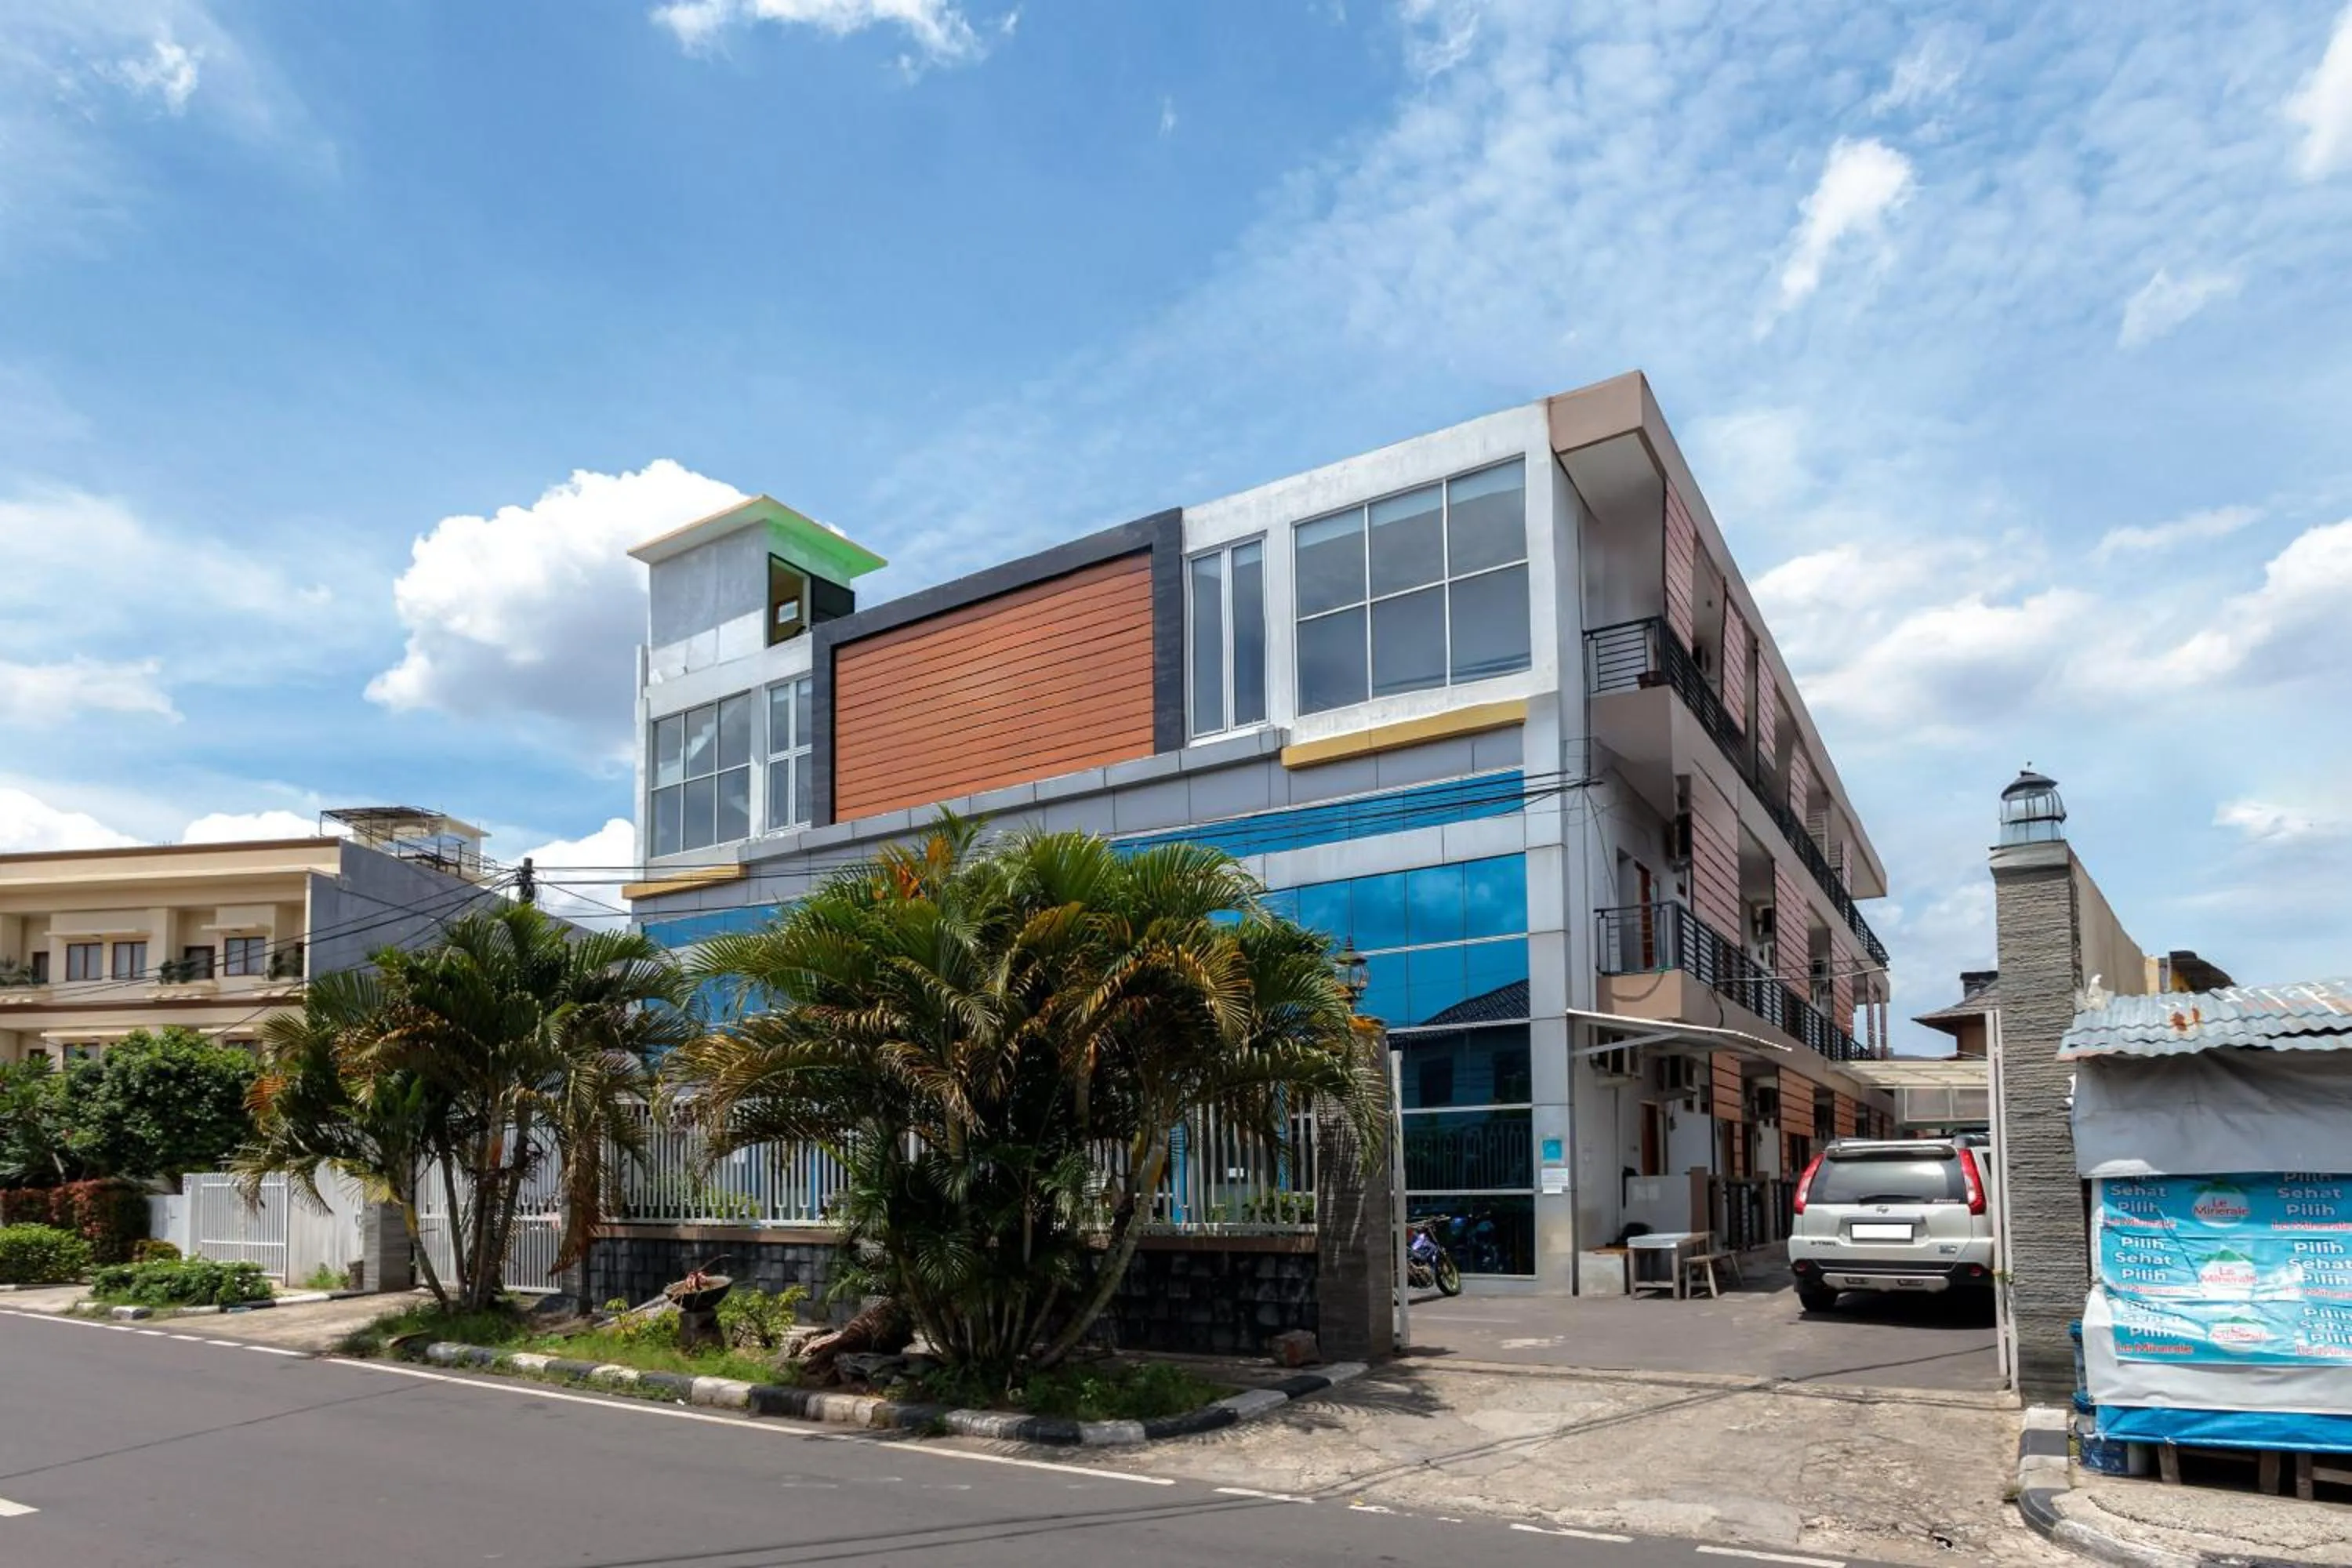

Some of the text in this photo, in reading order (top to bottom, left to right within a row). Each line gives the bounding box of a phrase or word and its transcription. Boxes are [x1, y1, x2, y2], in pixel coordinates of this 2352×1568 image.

[2110, 1185, 2167, 1198] Sehat
[2278, 1187, 2342, 1200] Sehat
[2286, 1203, 2336, 1217] Pilih
[2122, 1237, 2164, 1249] Pilih
[2294, 1241, 2344, 1254] Pilih
[2115, 1251, 2171, 1265] Sehat
[2288, 1258, 2352, 1270] Sehat
[2122, 1268, 2166, 1280] Pilih
